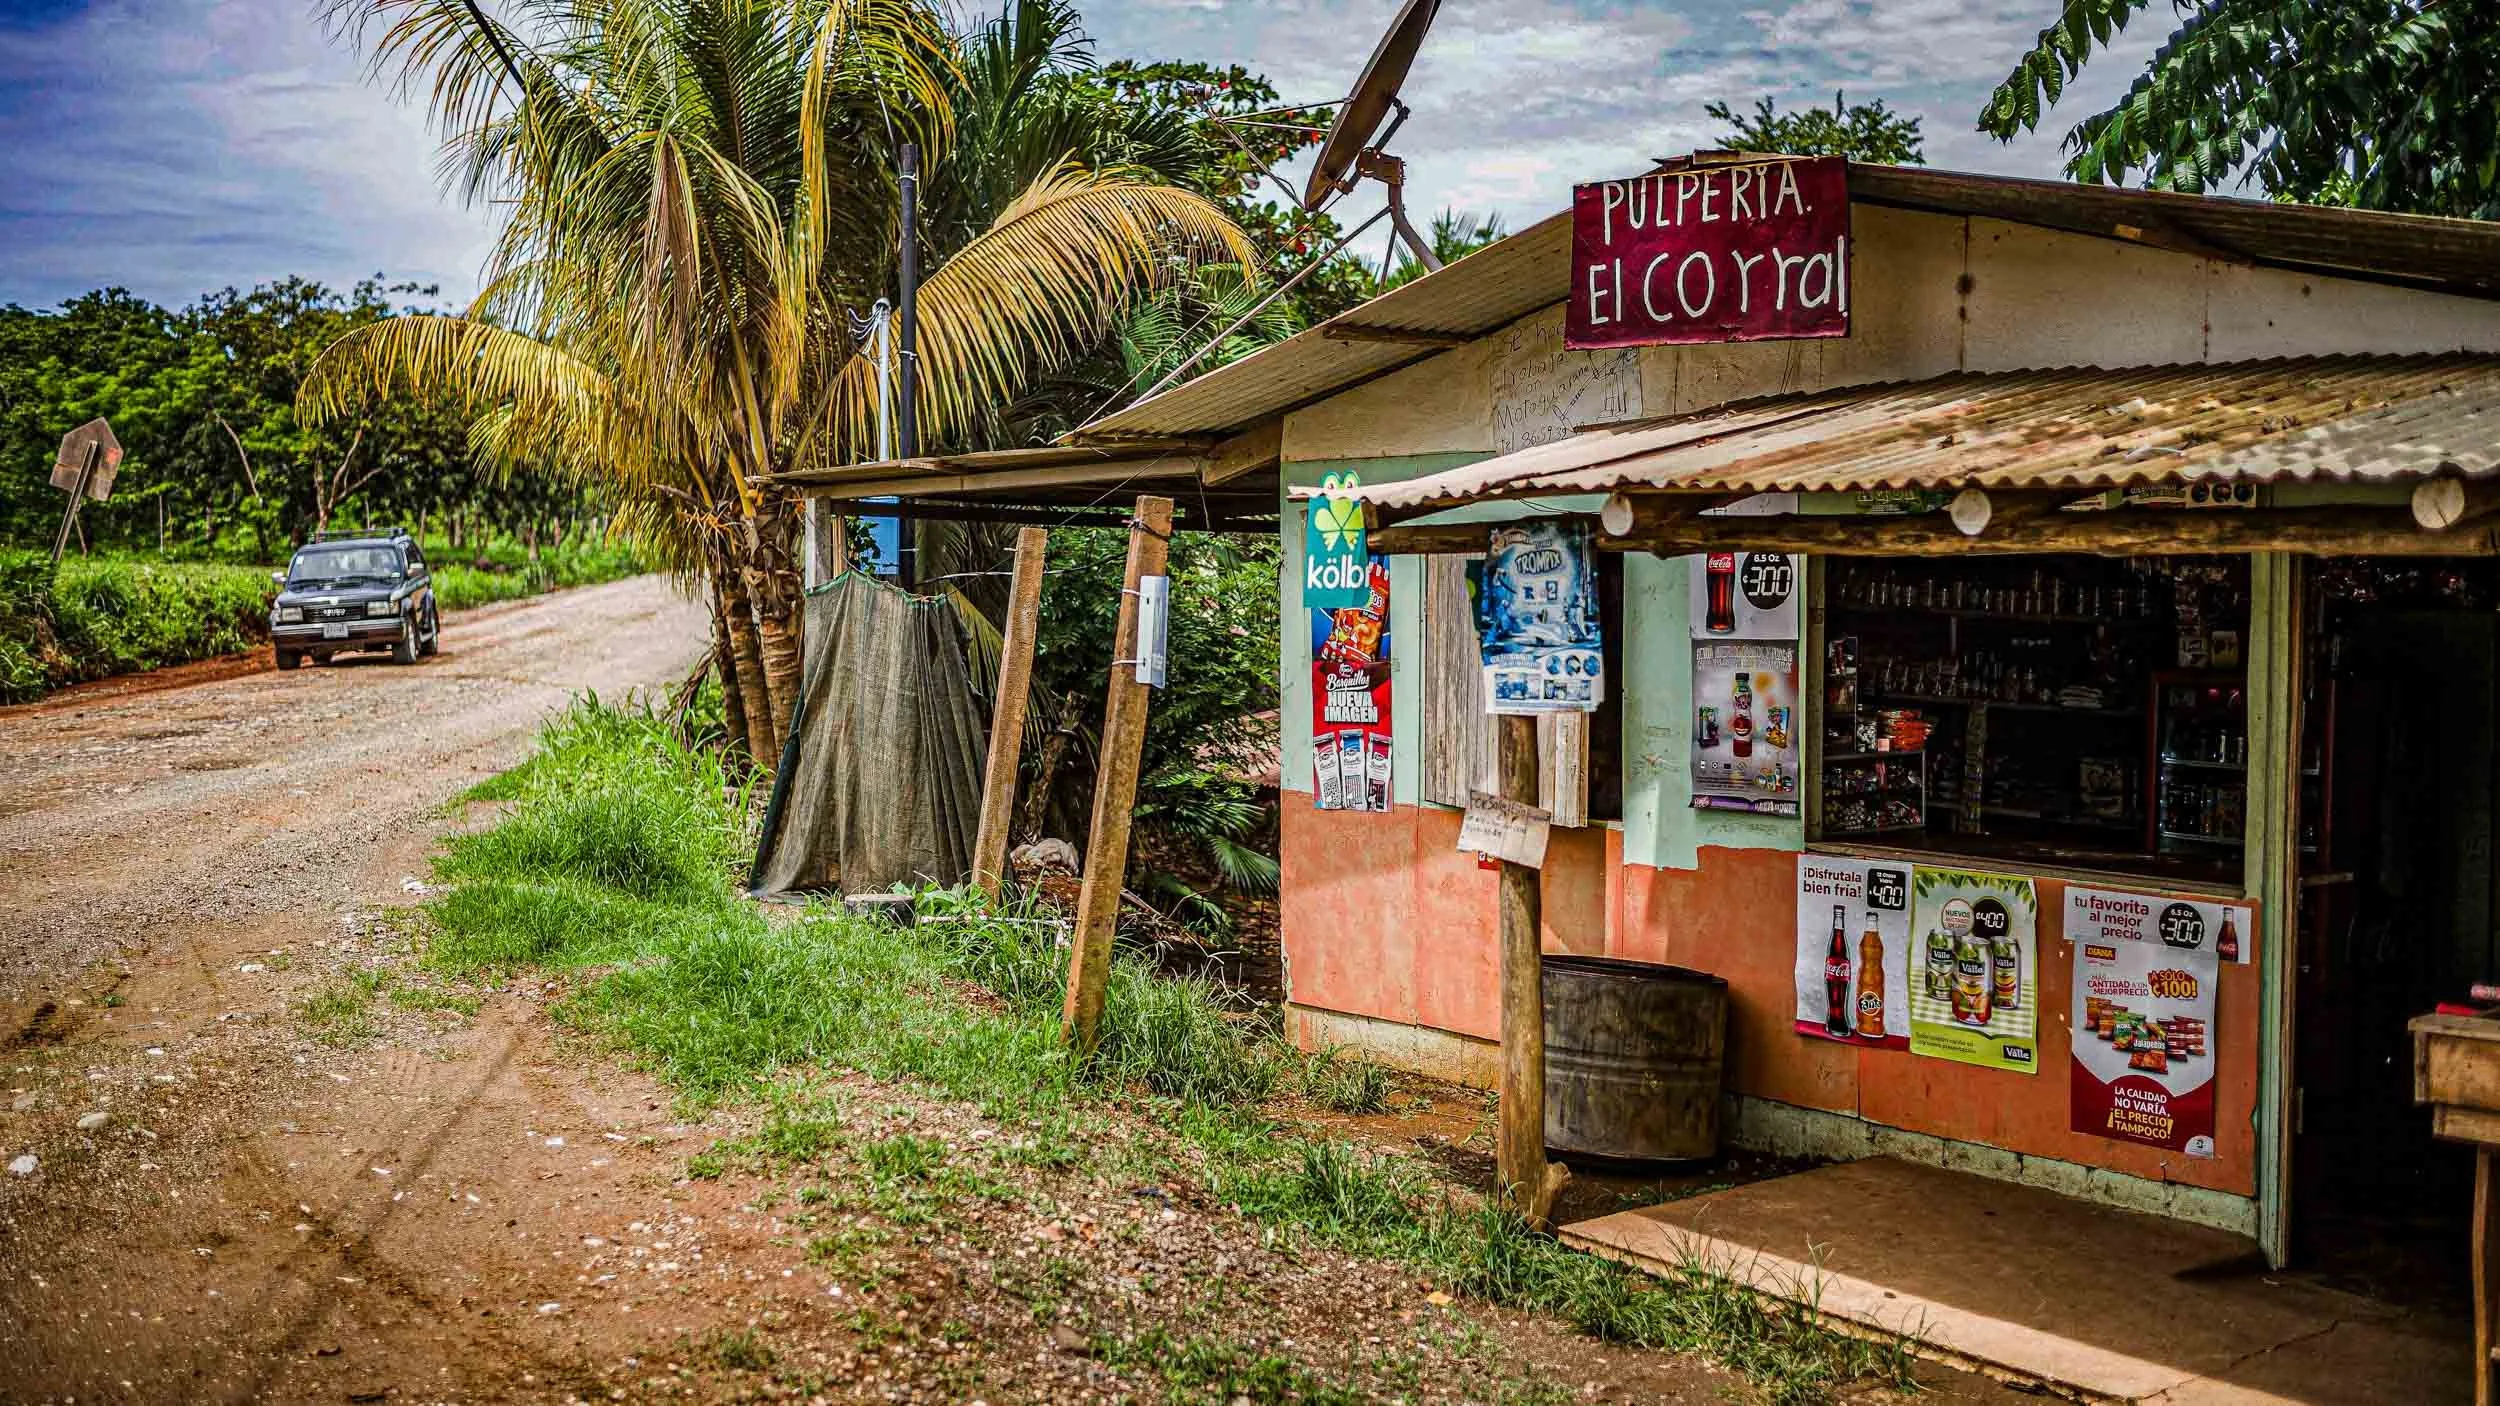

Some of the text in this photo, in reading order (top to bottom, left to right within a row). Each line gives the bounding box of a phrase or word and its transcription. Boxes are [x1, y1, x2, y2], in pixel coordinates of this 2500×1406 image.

[1327, 690, 1373, 707] NUEVA
[1324, 706, 1378, 723] IMAGEN
[1803, 880, 1831, 895] bien
[2075, 896, 2149, 915] tu favorita
[2089, 910, 2143, 927] al mejor
[2101, 926, 2143, 941] precio
[2151, 972, 2158, 980] A
[2088, 980, 2130, 989] CANTIDAD
[2119, 988, 2149, 997] PRECIO
[2115, 1086, 2167, 1104] LA CALIDAD
[2115, 1097, 2131, 1109] NO
[2129, 1111, 2167, 1127] PRECIO
